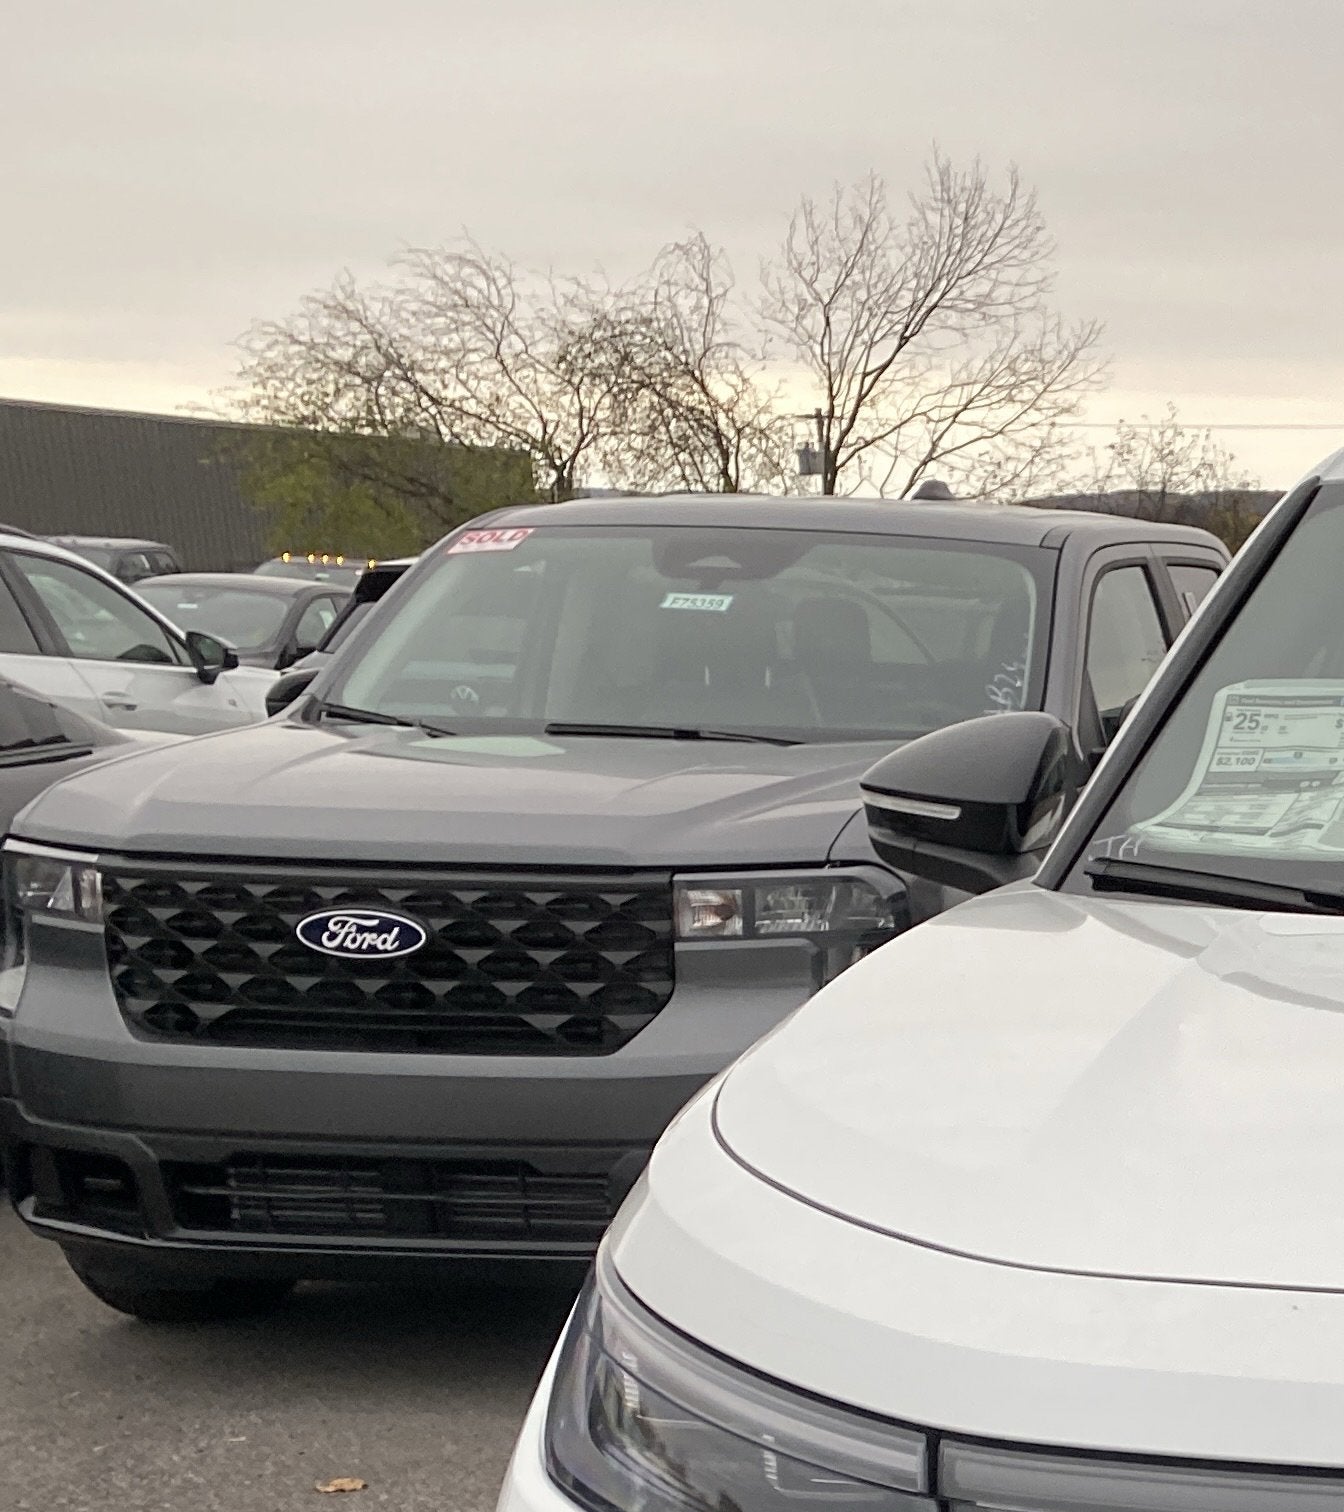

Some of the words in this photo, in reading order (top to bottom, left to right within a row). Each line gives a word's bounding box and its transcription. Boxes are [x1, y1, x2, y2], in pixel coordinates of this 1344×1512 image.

[460, 528, 530, 545] SOLD
[1233, 713, 1262, 731] 25
[321, 915, 401, 951] Ford
